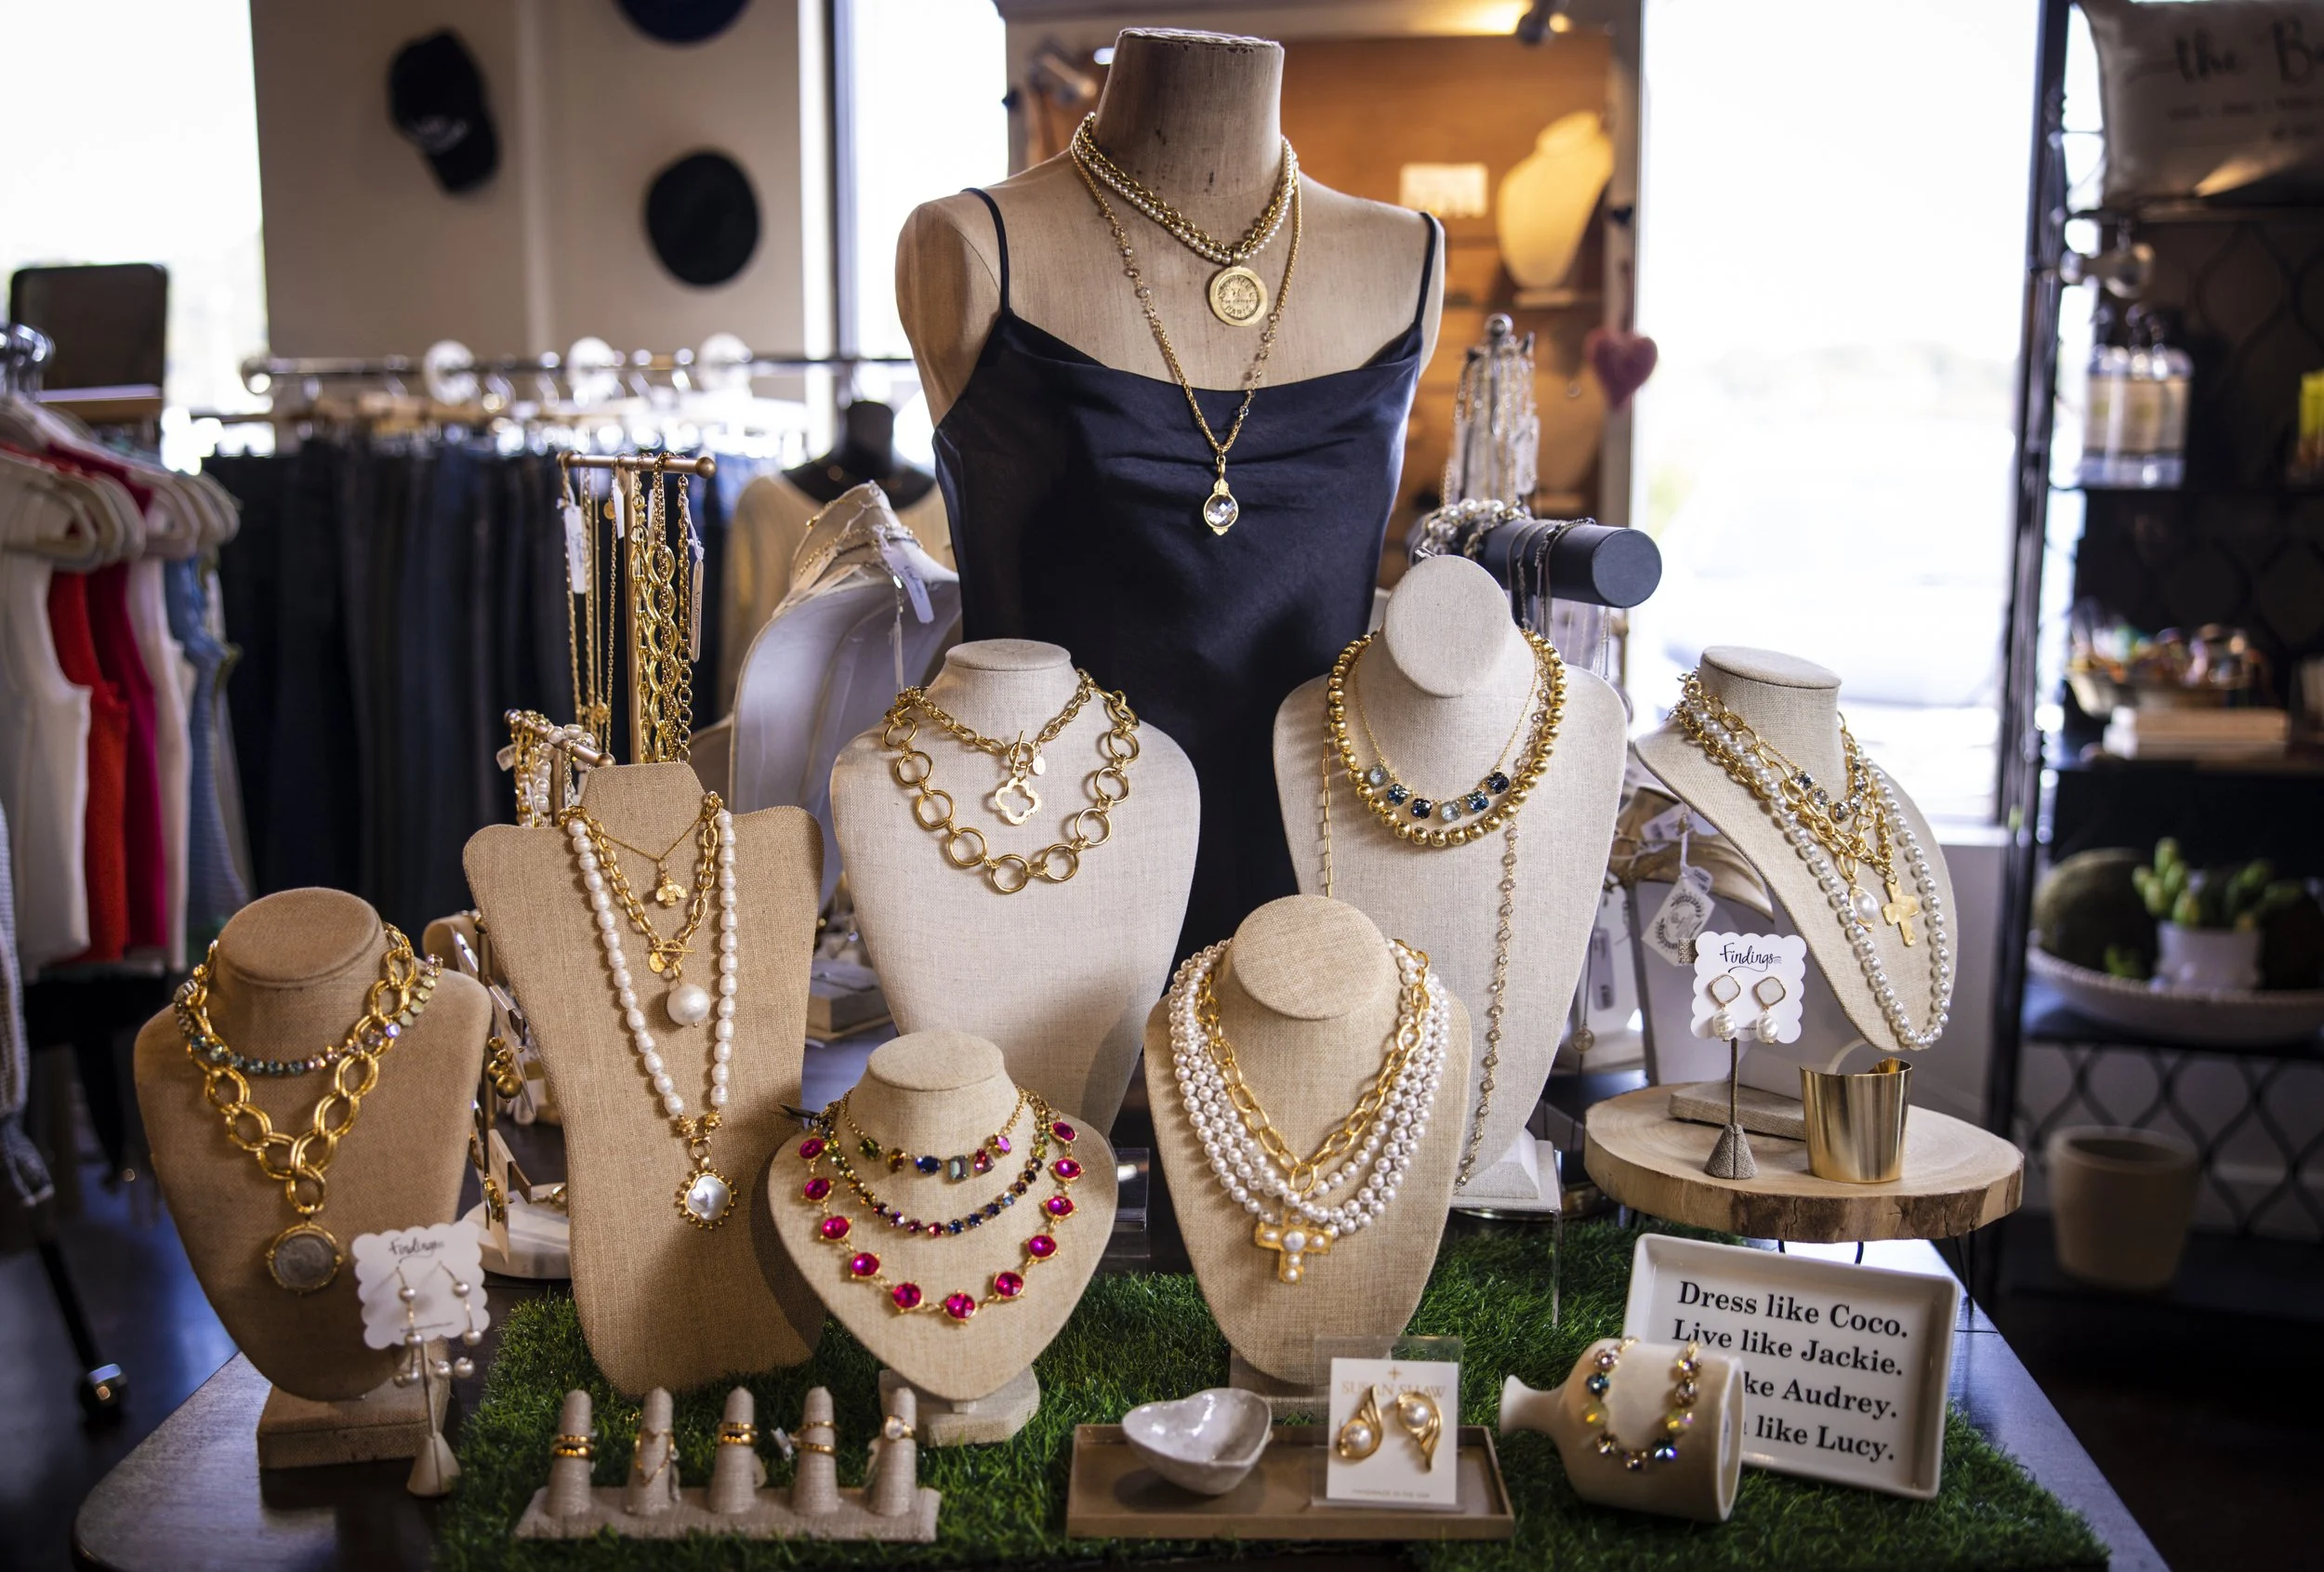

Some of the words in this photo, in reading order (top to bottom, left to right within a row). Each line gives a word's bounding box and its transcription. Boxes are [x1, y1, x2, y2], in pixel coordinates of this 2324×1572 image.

[1719, 942, 1781, 972] Findings
[1677, 1280, 1757, 1315] Dress
[1765, 1293, 1819, 1325] like
[1829, 1303, 1908, 1339] Coco.
[1671, 1318, 1733, 1349] Live
[1740, 1328, 1793, 1359] like
[1800, 1339, 1904, 1378] Jackie.
[1744, 1370, 1775, 1398] ke
[1780, 1378, 1898, 1420] Audrey.
[1754, 1414, 1809, 1447] like
[1815, 1424, 1895, 1462] Lucy.
